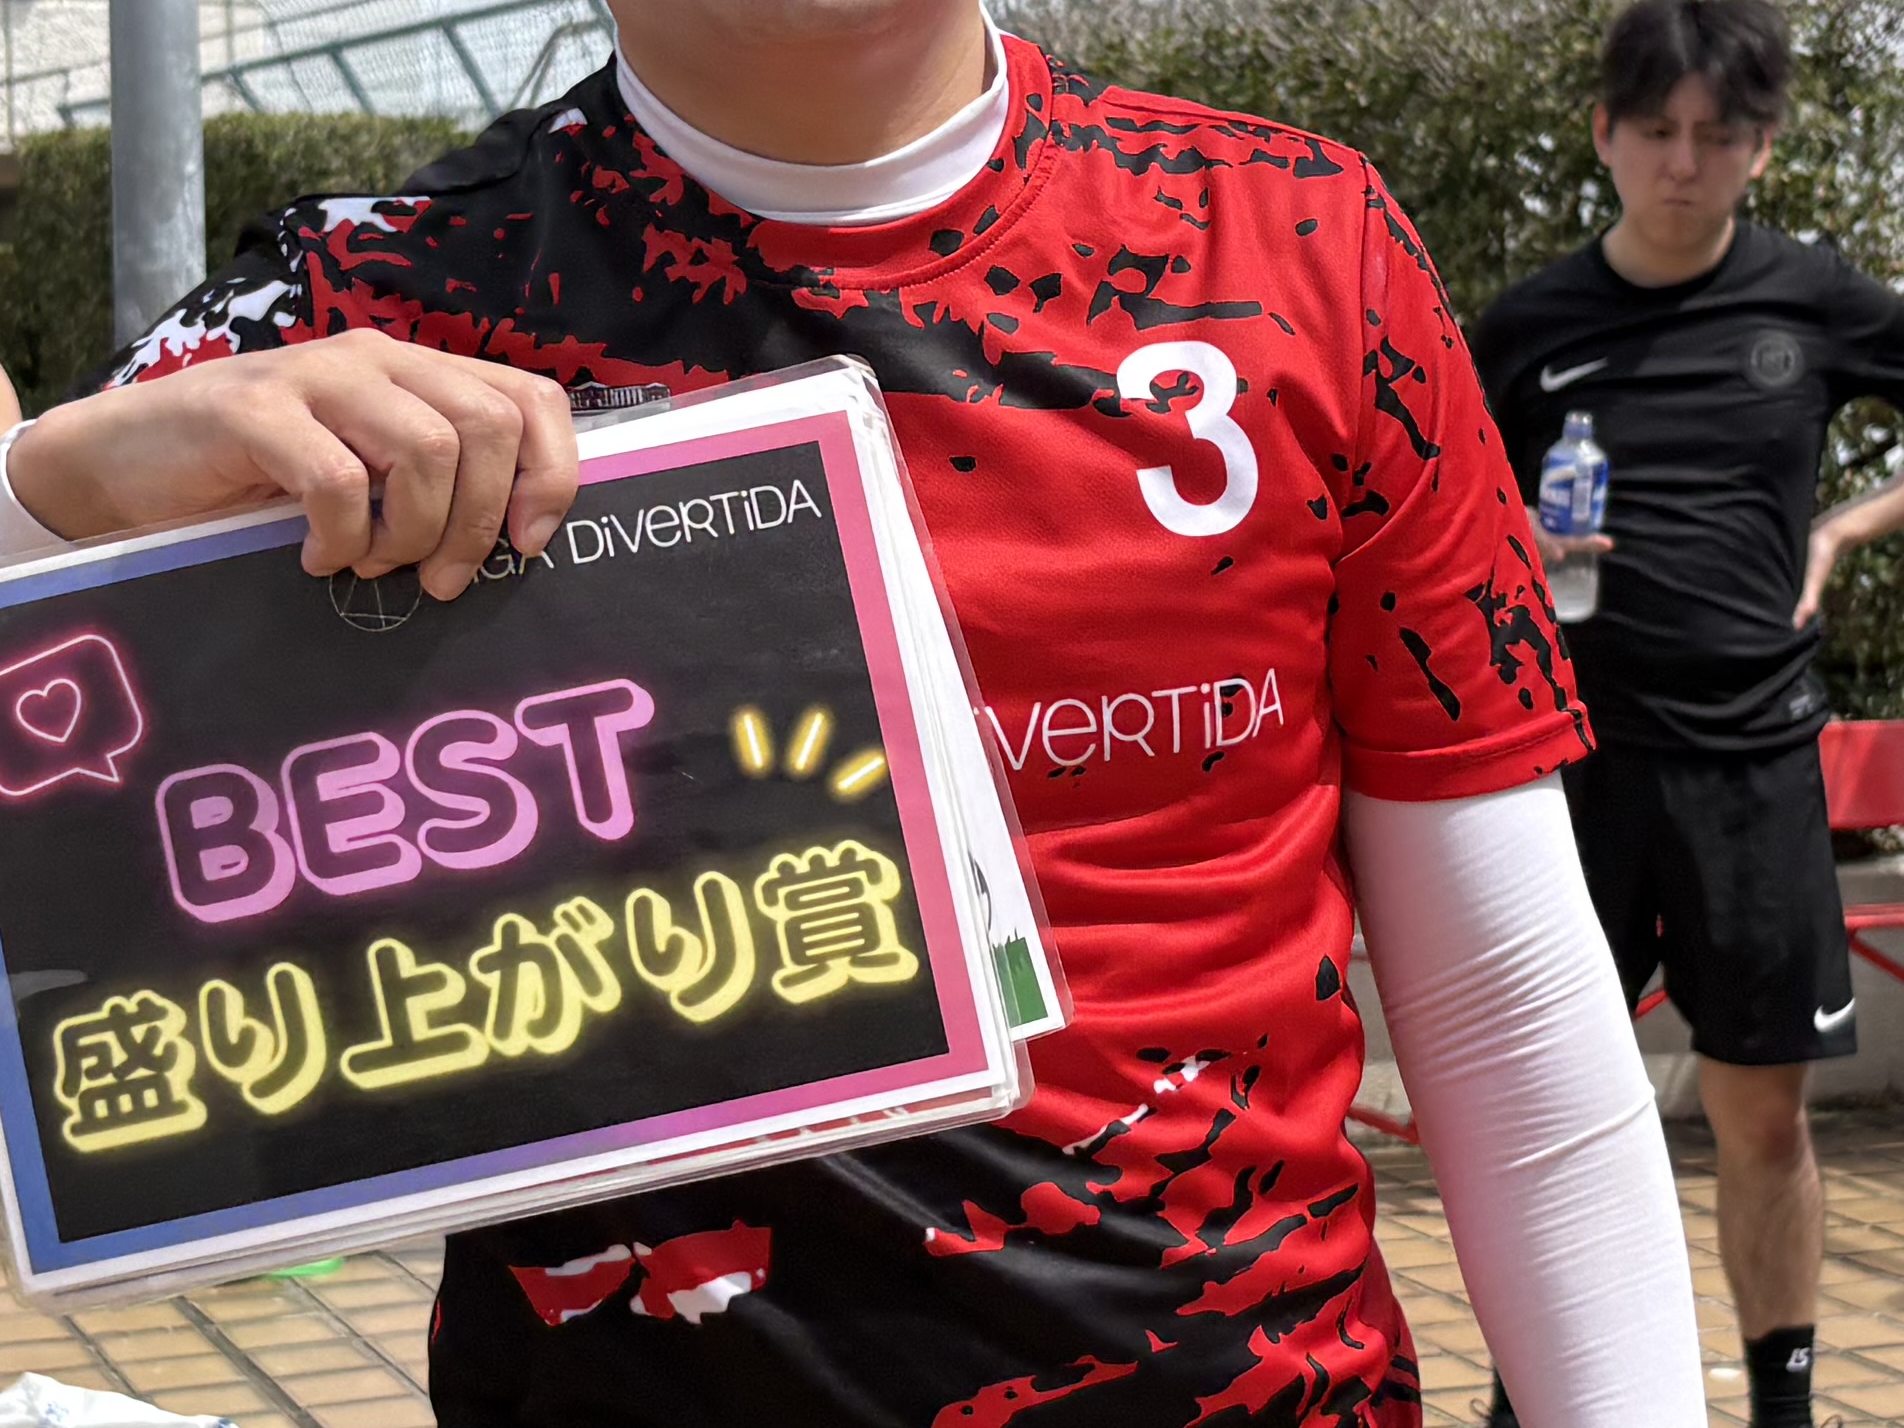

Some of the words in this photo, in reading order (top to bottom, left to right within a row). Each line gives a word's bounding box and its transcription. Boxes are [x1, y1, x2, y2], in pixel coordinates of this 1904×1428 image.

[1117, 340, 1259, 537] 3
[155, 677, 655, 924] BEST
[973, 667, 1285, 772] VeRTiDA
[51, 838, 919, 1155] 盛り上がり賞
